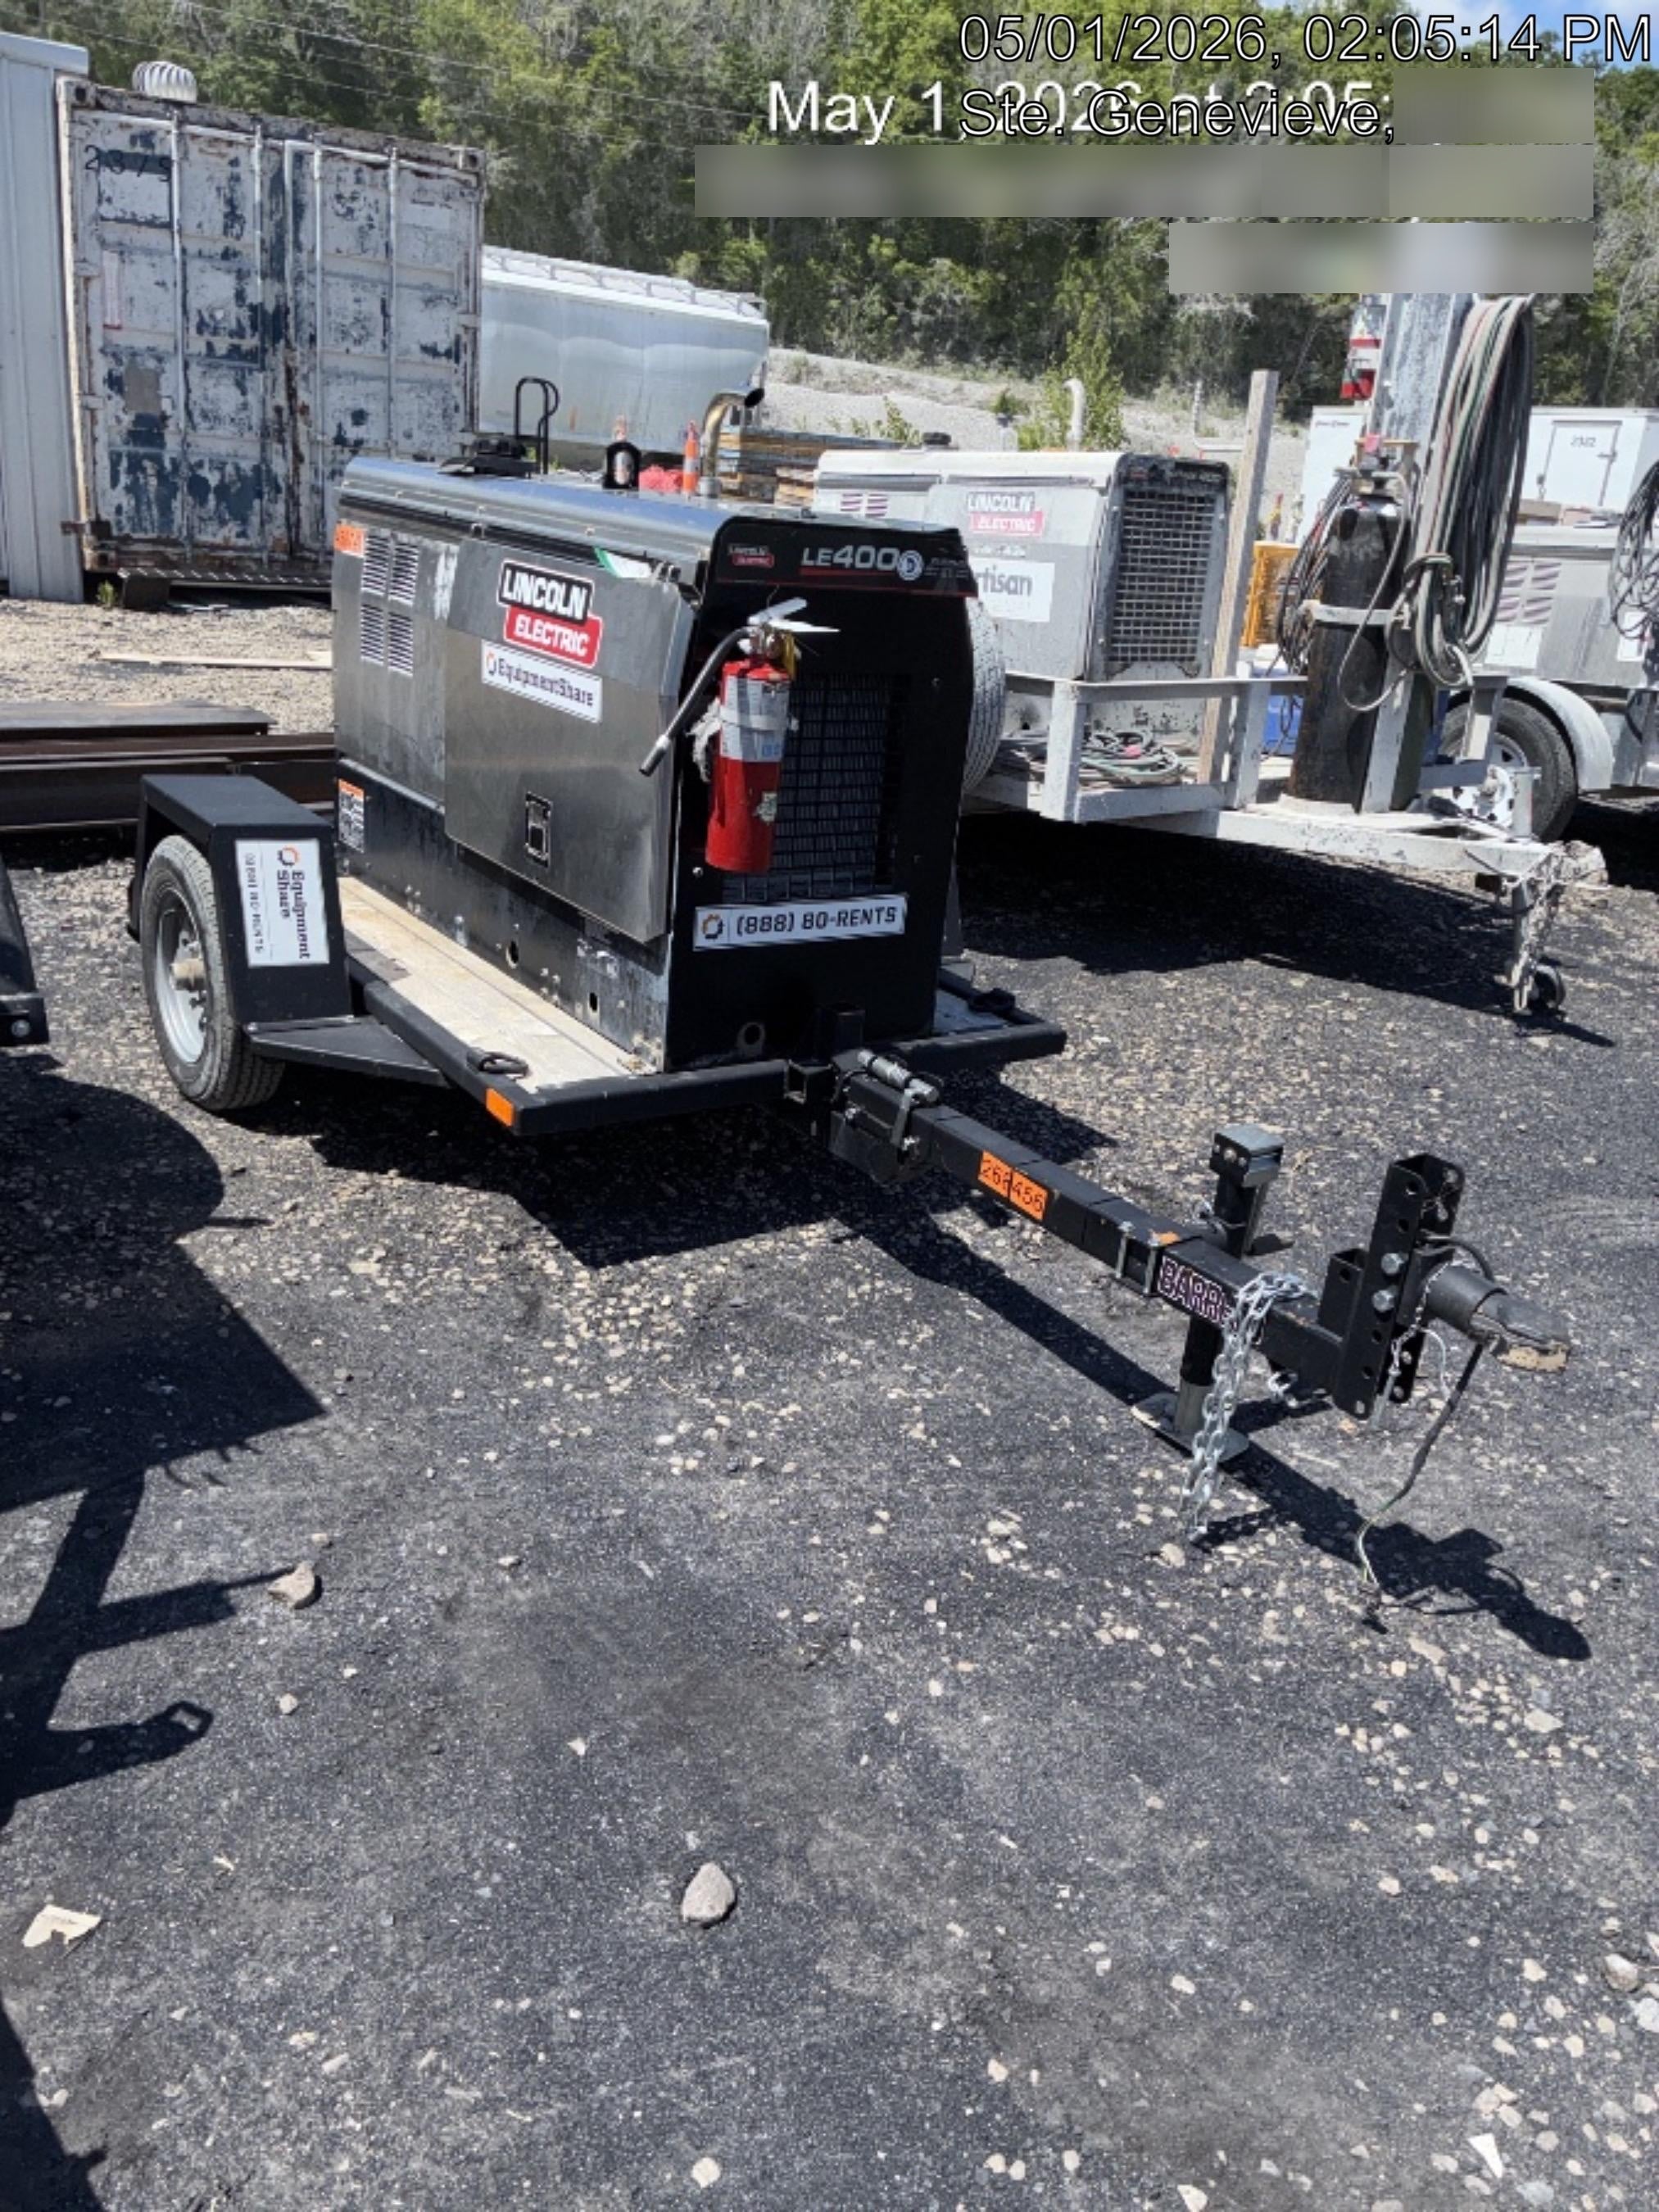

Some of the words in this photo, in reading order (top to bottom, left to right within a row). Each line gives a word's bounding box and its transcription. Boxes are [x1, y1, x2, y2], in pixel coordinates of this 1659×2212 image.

[968, 492, 1032, 513] LINCOLN
[977, 515, 1037, 533] ELECTRIC
[501, 568, 588, 620] LINCOLN
[513, 614, 590, 657] ELECTRIC
[498, 657, 593, 707] EquipmentShare
[276, 869, 291, 920] Share
[290, 869, 311, 959] Equipment
[737, 911, 795, 936] (888)
[800, 905, 898, 931] 80-RENTS
